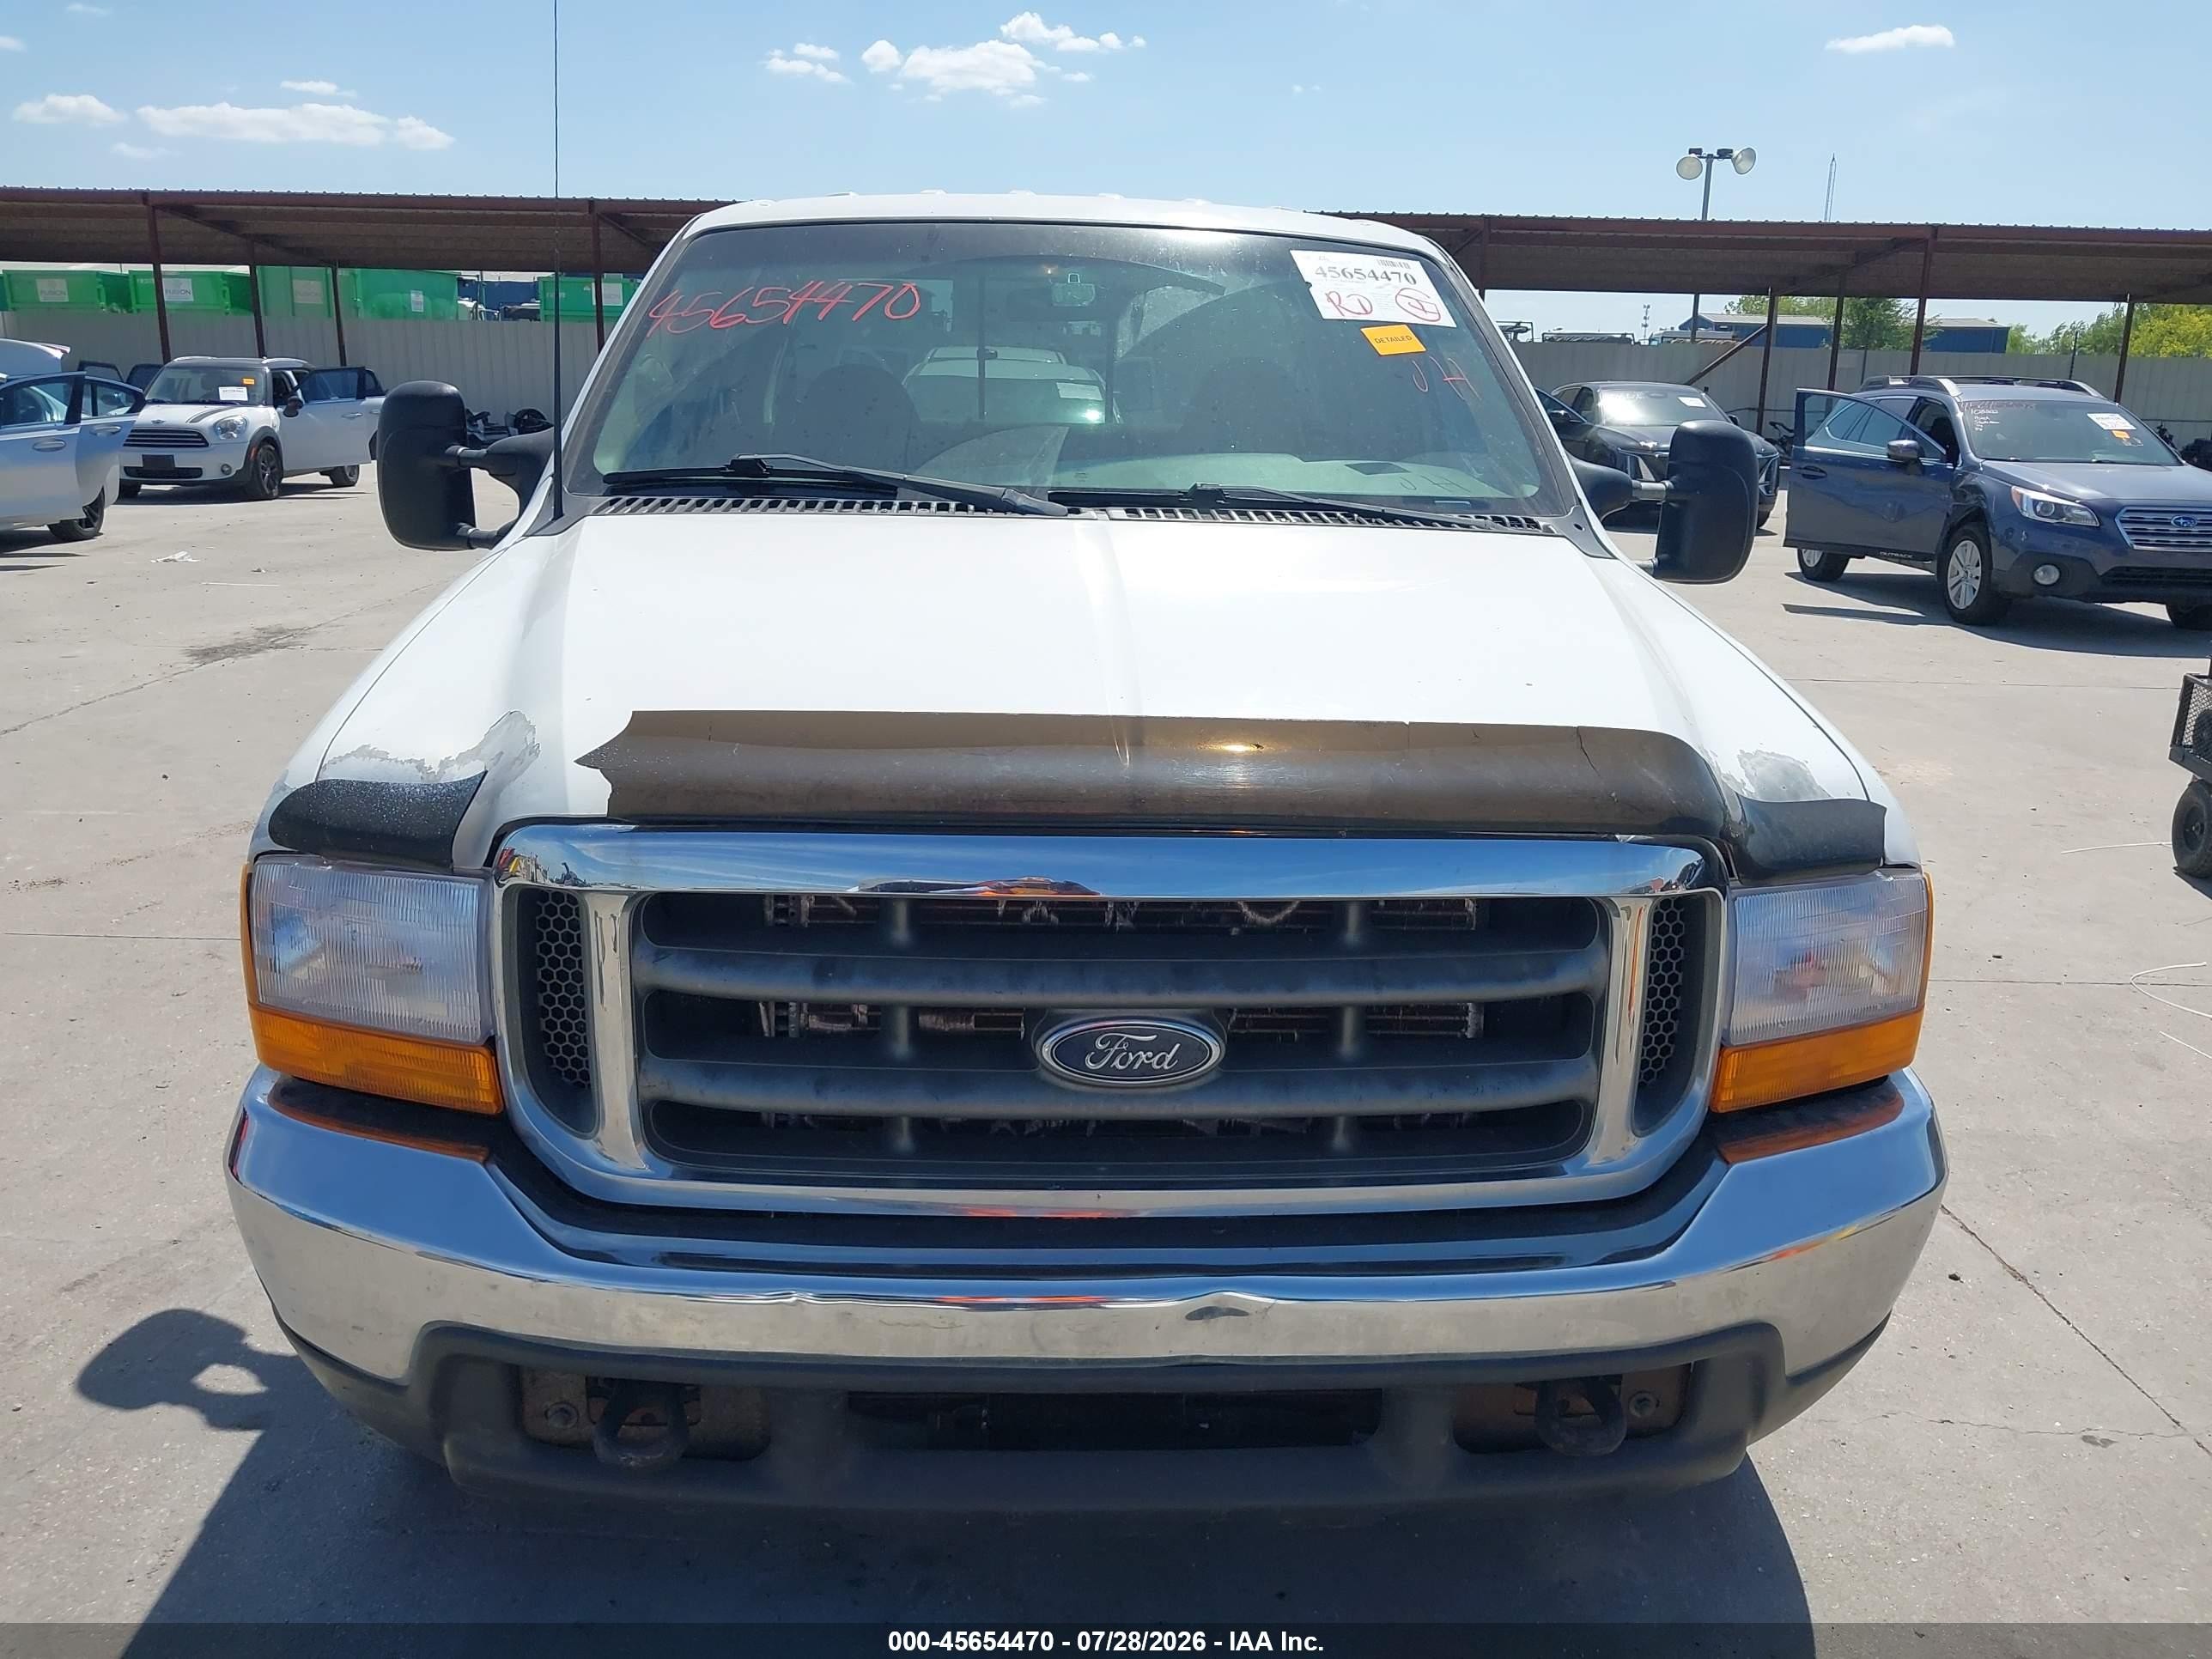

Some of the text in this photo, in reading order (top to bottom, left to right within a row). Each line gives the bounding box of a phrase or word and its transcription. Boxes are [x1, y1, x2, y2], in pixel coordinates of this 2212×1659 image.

[1315, 265, 1418, 286] 45654470
[646, 280, 921, 337] 45654470
[1375, 336, 1413, 344] DETAILED
[1085, 1032, 1181, 1070] Ford
